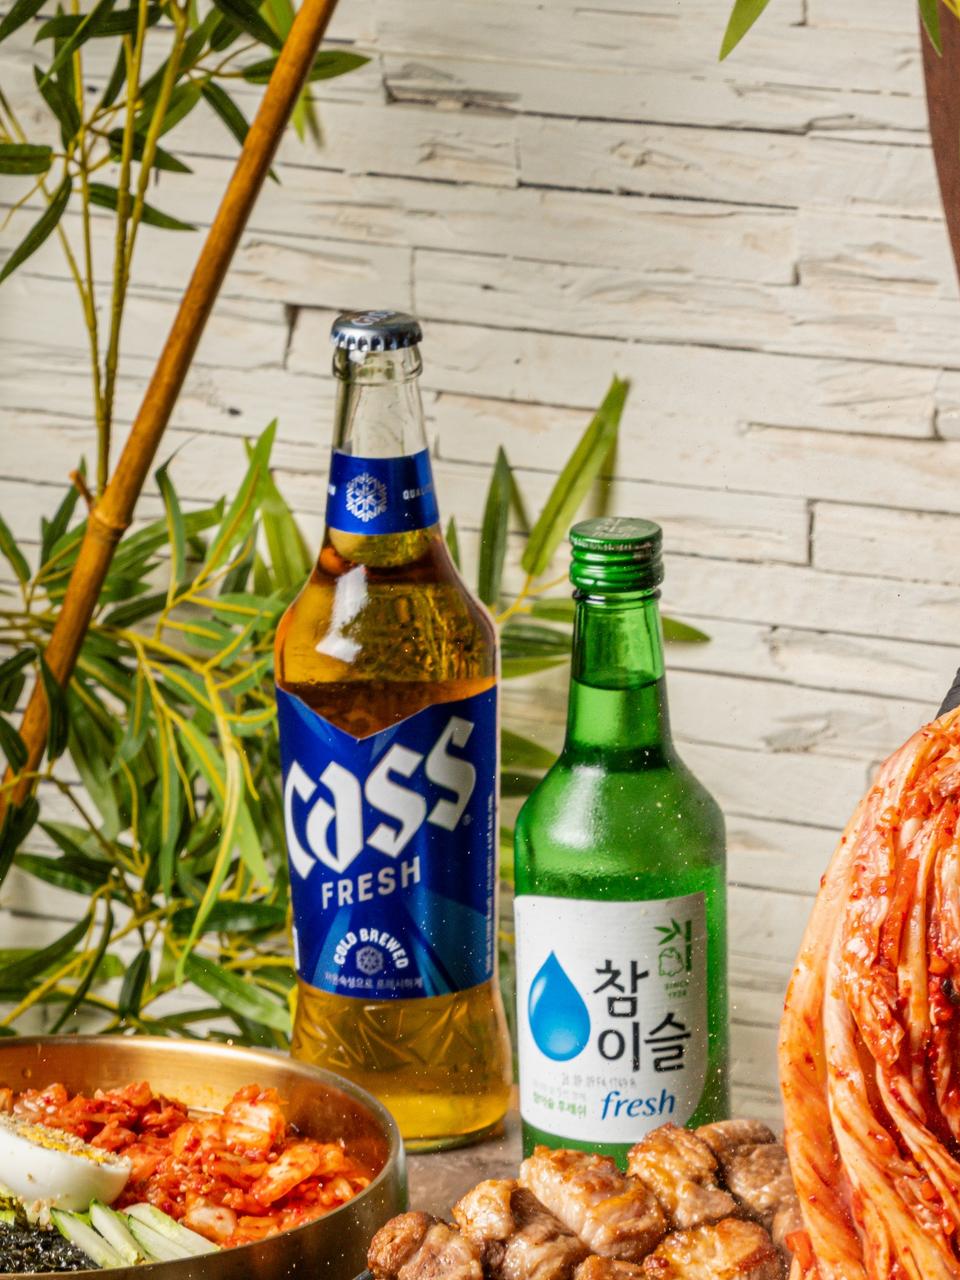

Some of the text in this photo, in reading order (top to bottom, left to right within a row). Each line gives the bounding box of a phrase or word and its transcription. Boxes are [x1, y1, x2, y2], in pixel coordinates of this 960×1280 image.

[322, 856, 422, 910] FRESH
[333, 927, 409, 969] COLD BREWED
[593, 959, 649, 1018] 참
[597, 1012, 692, 1073] 이슬
[601, 1088, 675, 1121] fresh
